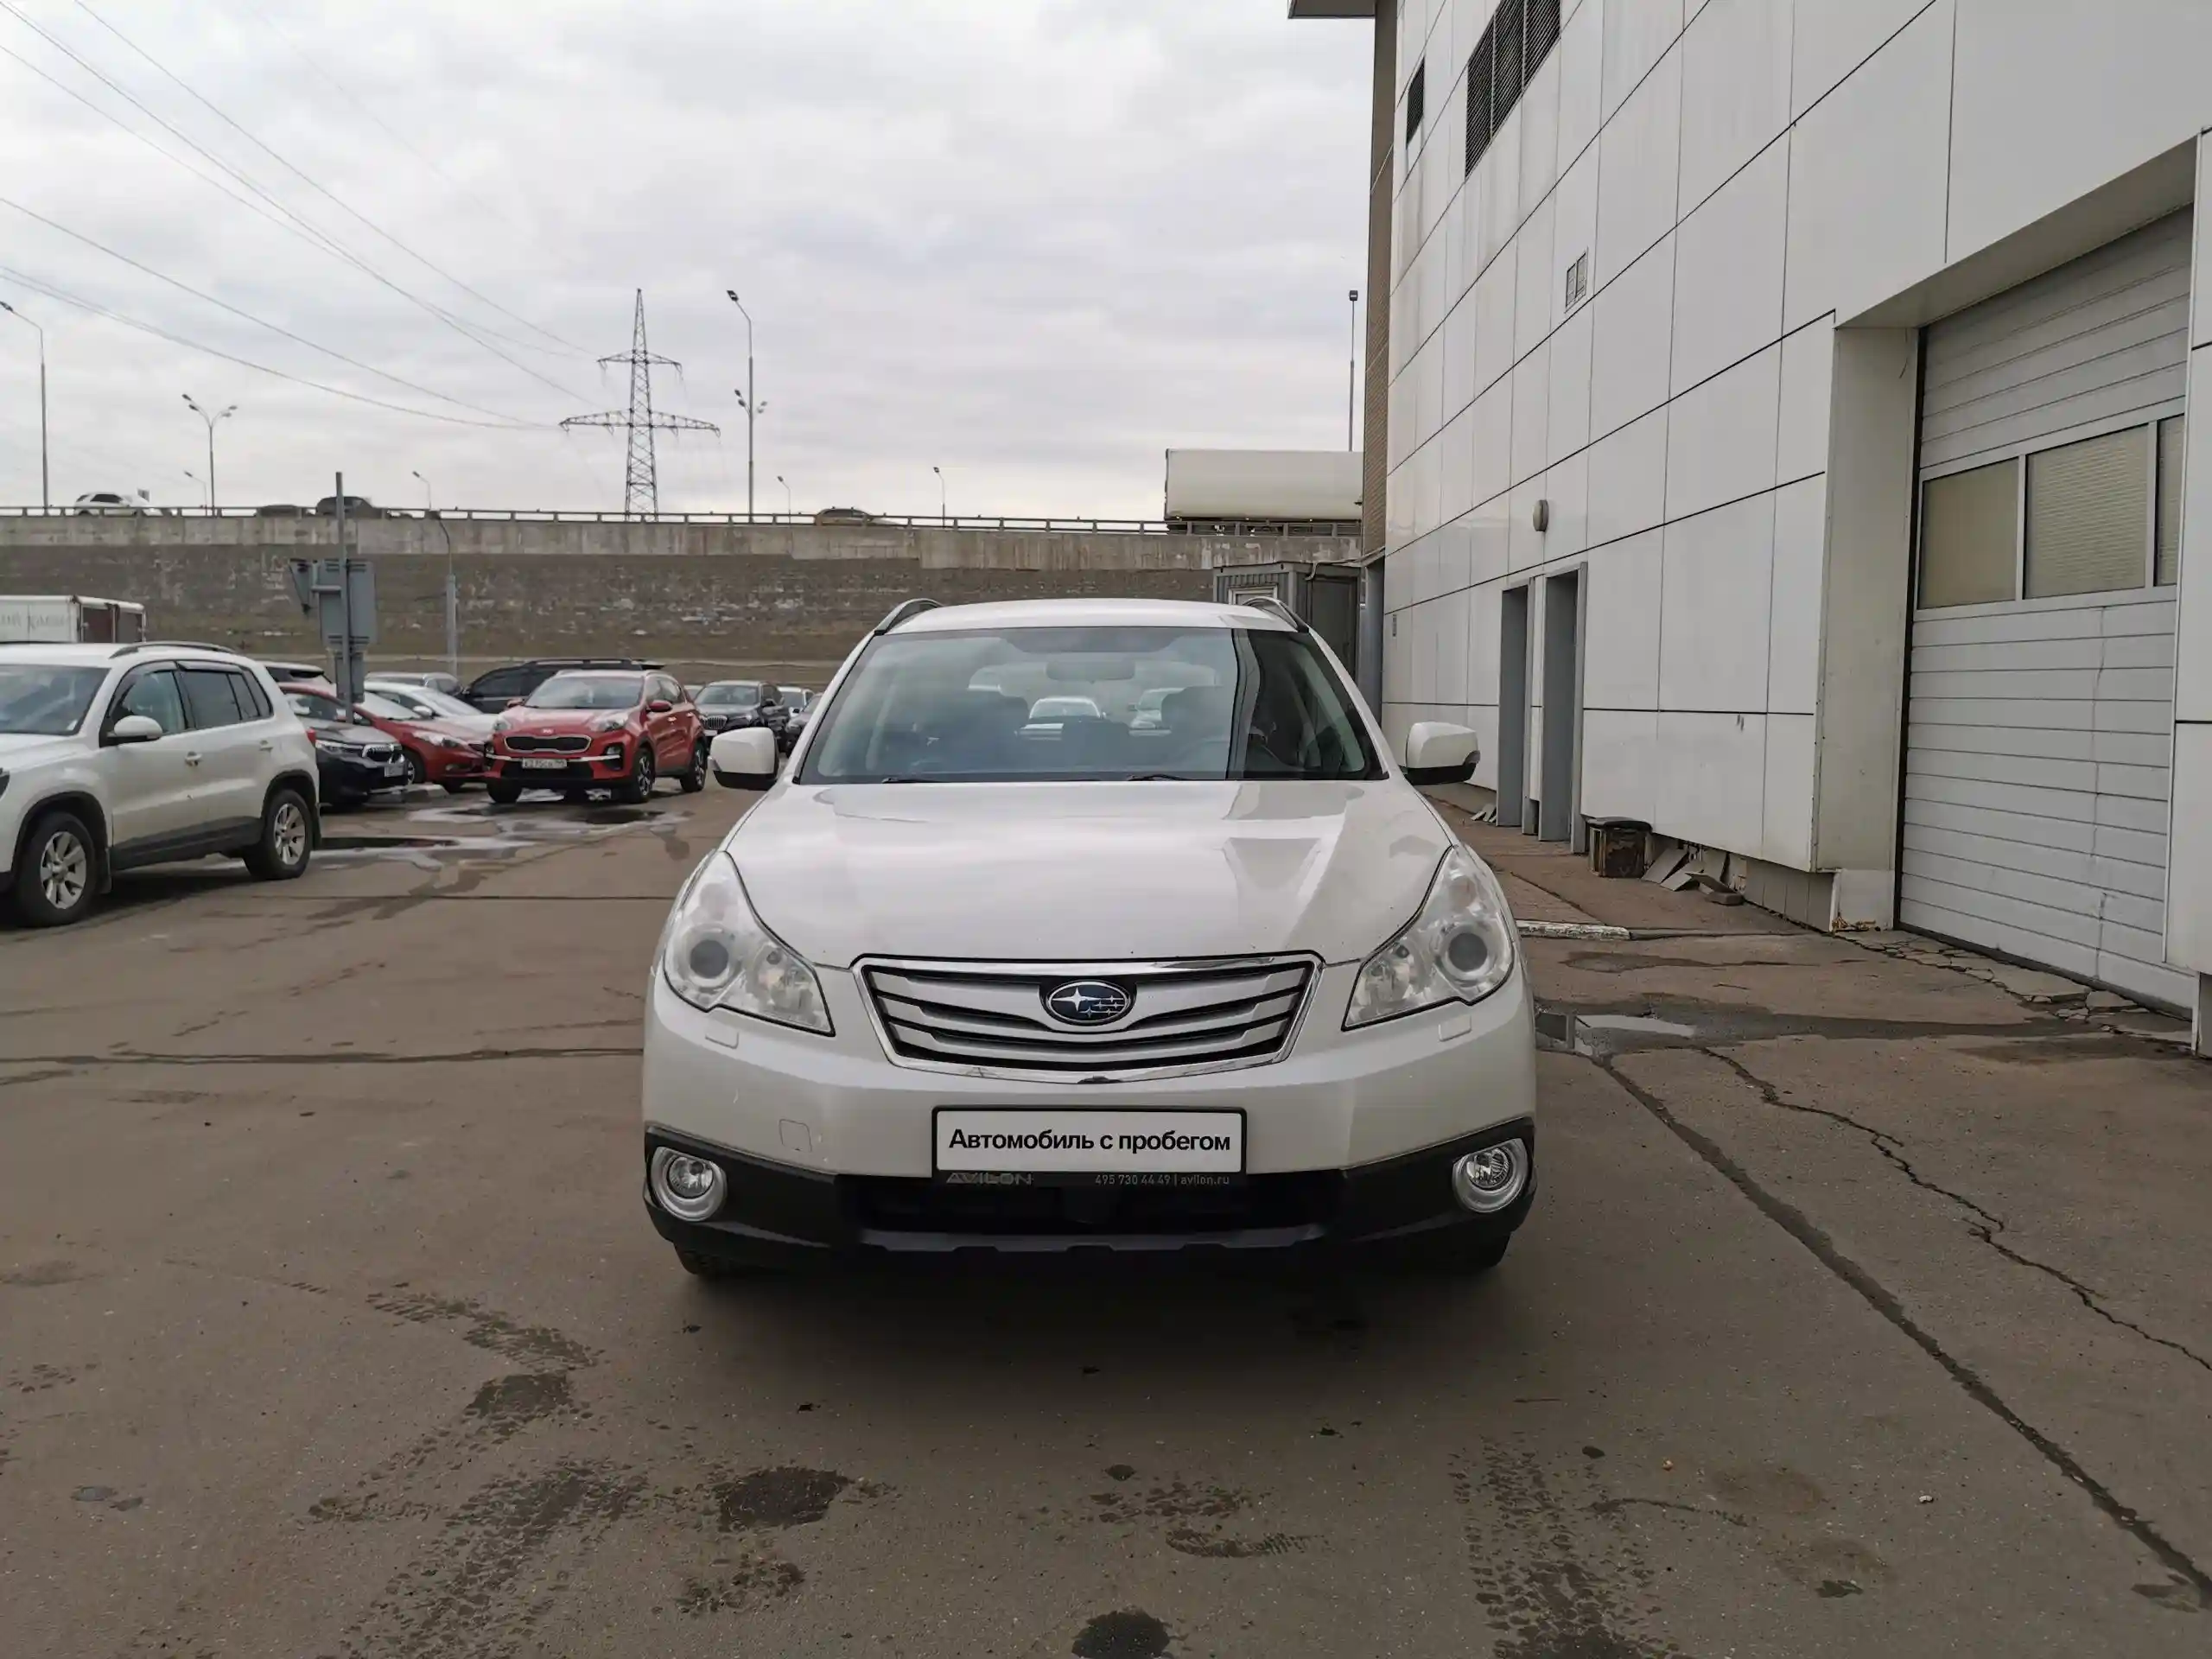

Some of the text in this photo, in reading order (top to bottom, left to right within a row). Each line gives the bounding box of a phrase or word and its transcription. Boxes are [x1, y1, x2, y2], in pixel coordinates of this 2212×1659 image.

[949, 1128, 1230, 1154] Автомобиль с пробегом
[946, 1173, 1033, 1185] AVILON
[1095, 1175, 1116, 1185] 495
[1117, 1175, 1136, 1185] 730
[1141, 1175, 1155, 1185] 44
[1158, 1175, 1171, 1185] 49
[1180, 1175, 1230, 1185] avilon.ru
